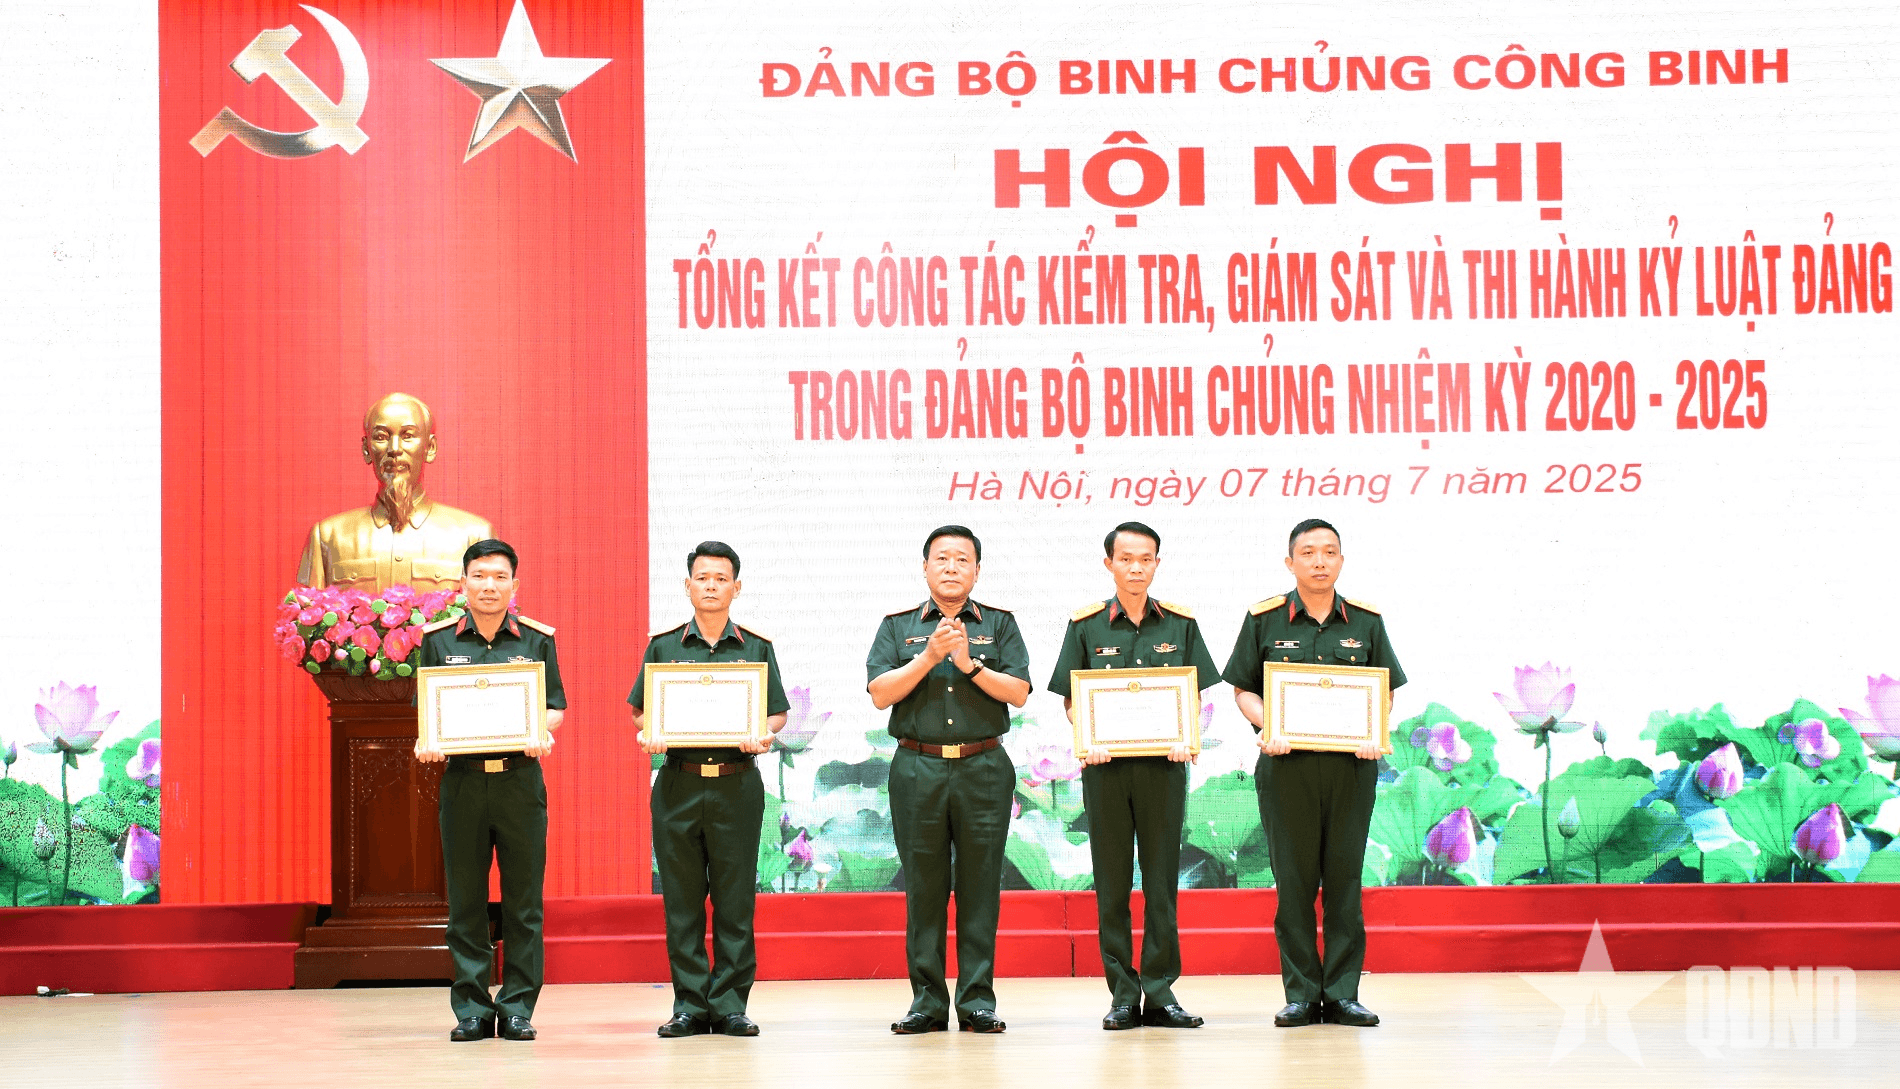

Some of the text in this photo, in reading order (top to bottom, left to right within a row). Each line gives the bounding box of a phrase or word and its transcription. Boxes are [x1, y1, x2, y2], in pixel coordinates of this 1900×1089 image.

[759, 40, 1788, 109] ĐẢNG BỘ BINH CHỦNG CÔNG BINH
[994, 130, 1563, 229] HỘI NGHỊ
[673, 211, 1893, 333] TỔNG KẾT CÔNG TÁC KIỂM TRA, GIÁM SÁT VÀ THI HÀNH KỶ LUẬT ĐẢNG
[789, 367, 913, 442] TRONG
[924, 336, 1029, 440] ĐẢNG
[1041, 351, 1091, 455] BỘ
[1104, 364, 1194, 438] BINH
[1207, 333, 1335, 436] CHỦNG
[1348, 347, 1472, 451] NHIỆM
[1485, 345, 1532, 433] KỲ
[1544, 360, 1637, 433] 2020
[1676, 358, 1768, 431] 2025
[948, 463, 1642, 508] Hà Nội, ngày 07 tháng 7 năm 2025
